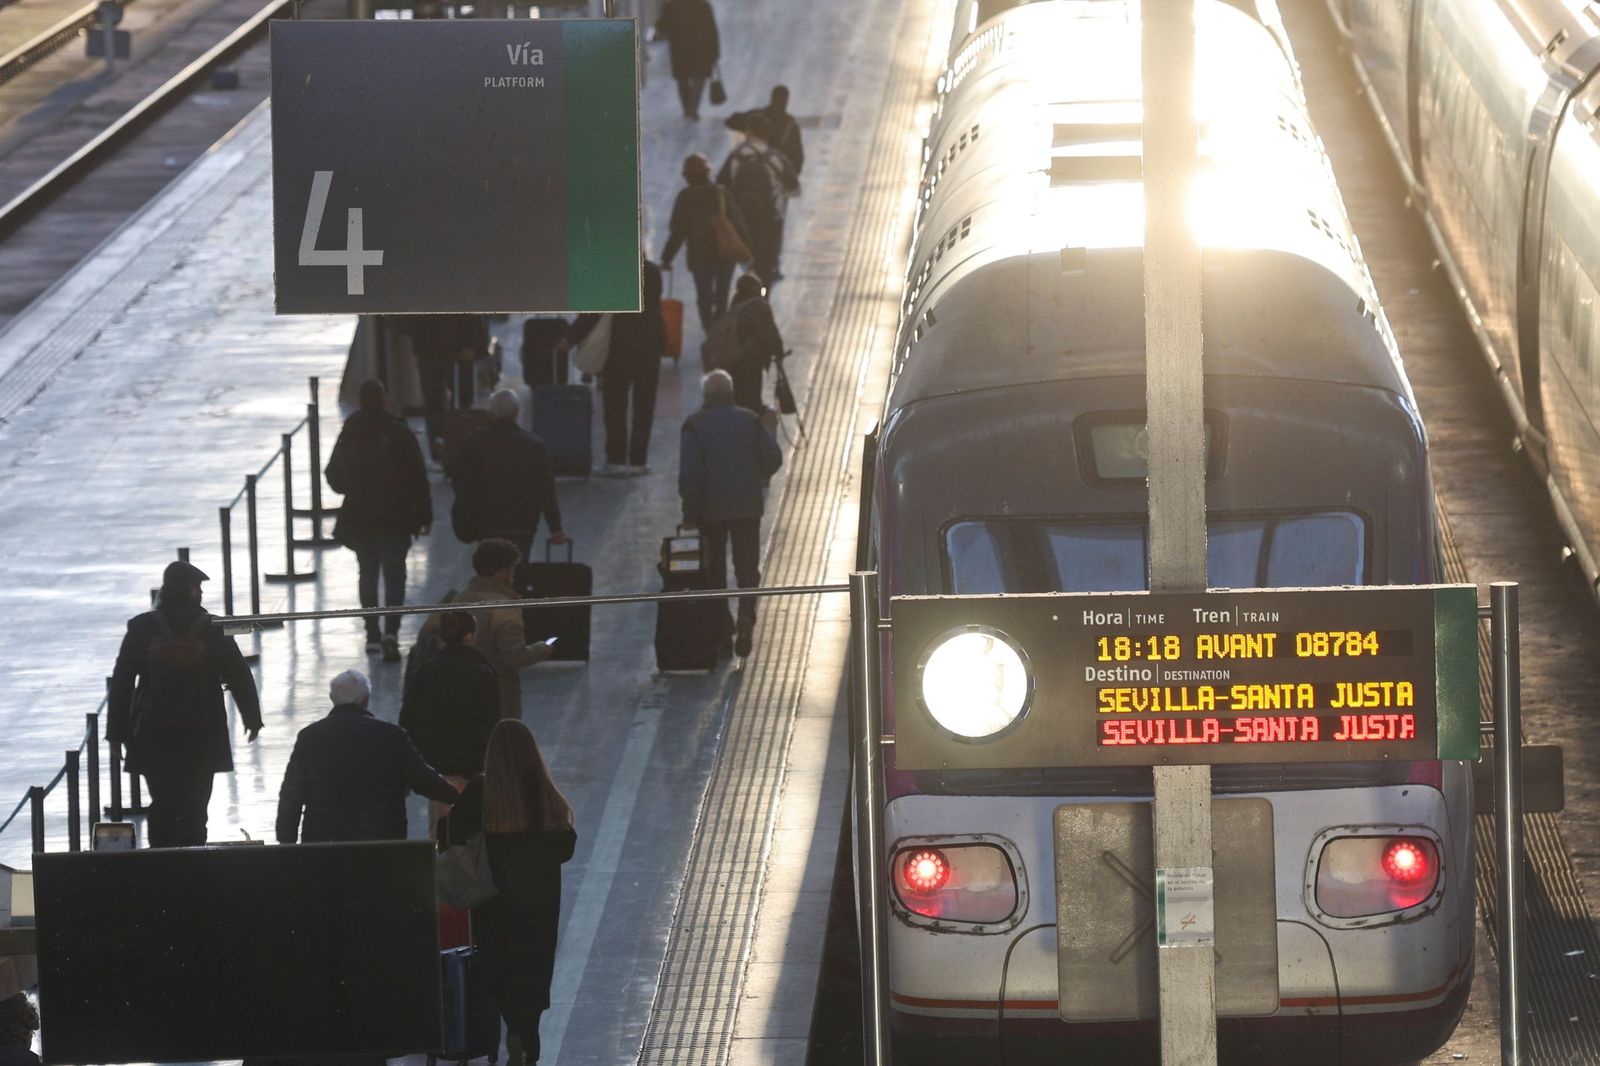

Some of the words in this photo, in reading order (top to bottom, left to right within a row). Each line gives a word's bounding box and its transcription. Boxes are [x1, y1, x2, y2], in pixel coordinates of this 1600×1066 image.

[506, 42, 545, 66] Vía
[484, 76, 545, 89] PLATFORM
[298, 170, 385, 296] 4
[1082, 610, 1123, 626] Hora
[1135, 613, 1165, 625] TIME
[1192, 608, 1231, 624] Tren
[1243, 612, 1280, 623] TRAIN
[1098, 635, 1181, 661] 18:18
[1197, 633, 1277, 659] AVANT
[1296, 631, 1380, 657] 08784
[1085, 665, 1152, 682] Destino
[1163, 670, 1231, 681] DESTINATION
[1099, 684, 1314, 713] SEVILLA-SANTA
[1330, 681, 1414, 708] JUSTA
[1102, 716, 1319, 745] SEVILLA-SANTA
[1333, 714, 1415, 740] JUSTA
